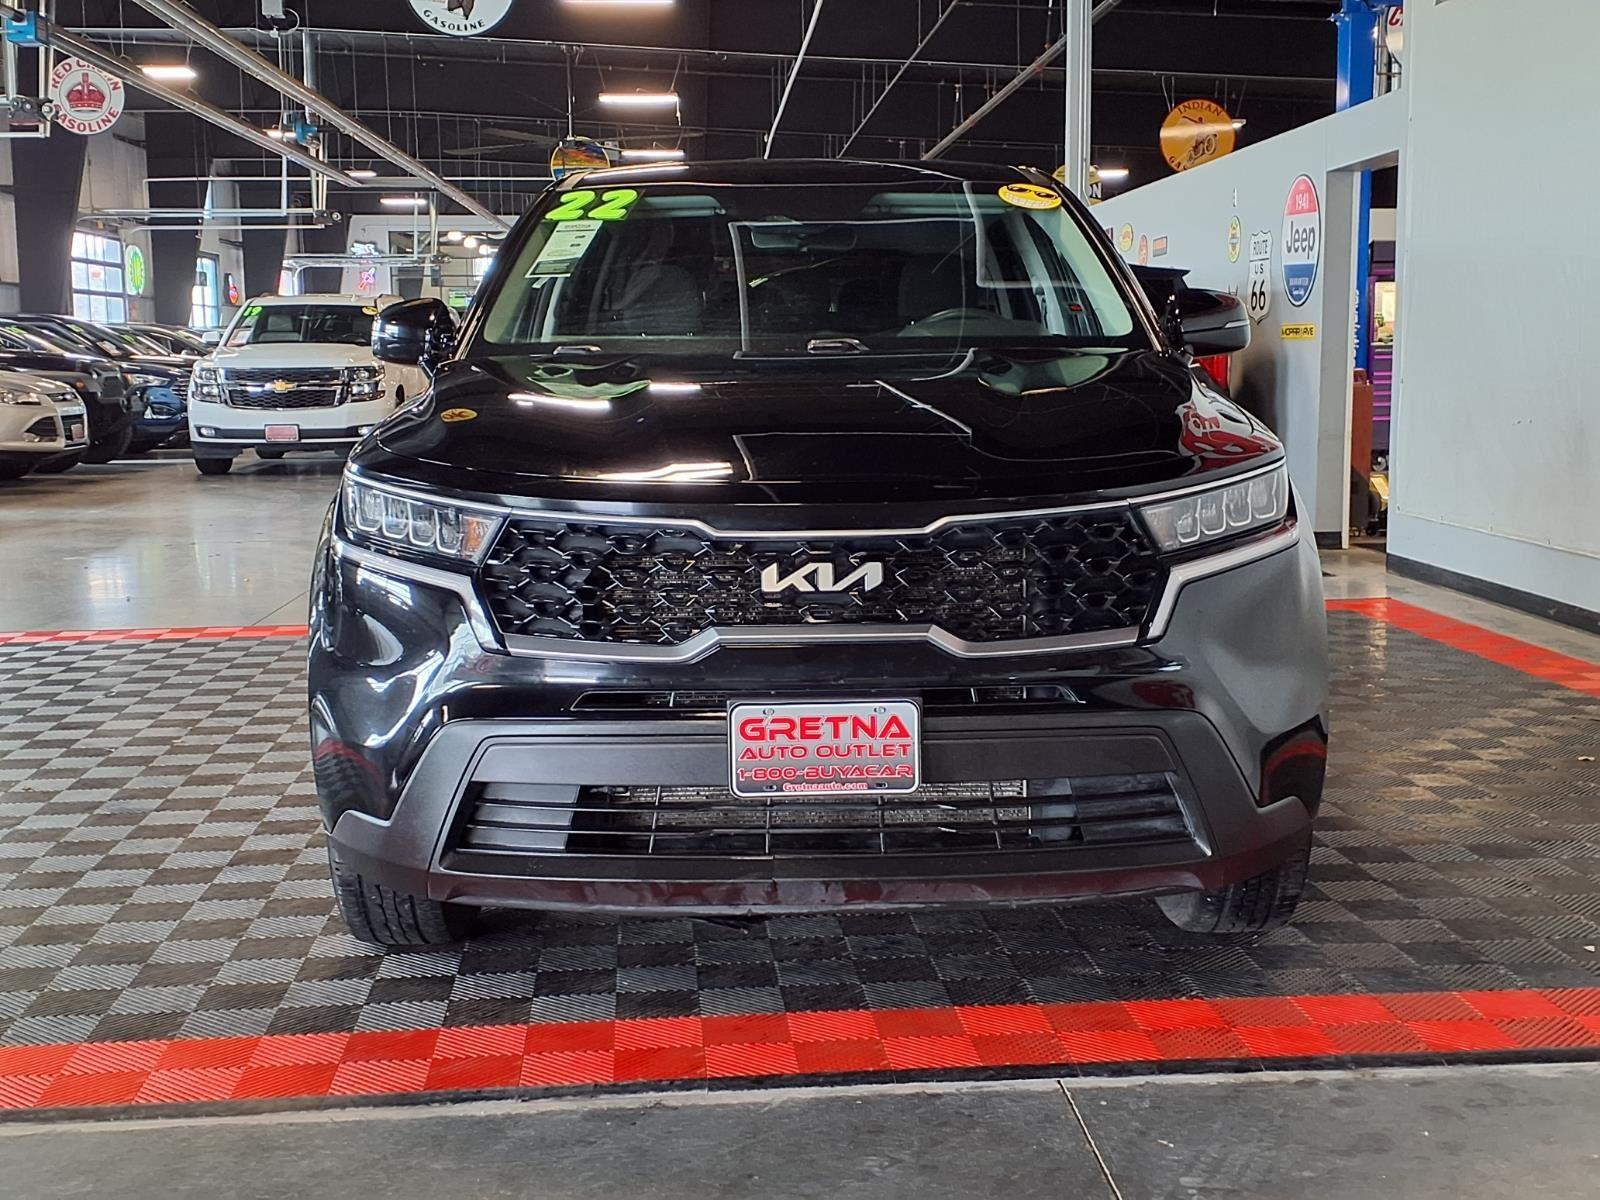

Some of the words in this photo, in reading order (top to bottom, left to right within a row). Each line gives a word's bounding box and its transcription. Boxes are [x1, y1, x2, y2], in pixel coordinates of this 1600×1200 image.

[423, 9, 486, 31] GASOLINE
[52, 62, 72, 89] RED
[1177, 101, 1222, 117] INDIAN
[545, 189, 638, 220] 22
[1295, 192, 1309, 211] 1941
[1253, 239, 1268, 256] ROUTE
[1286, 220, 1315, 259] Jeep
[1251, 278, 1266, 311] 66
[243, 306, 262, 316] 19
[738, 714, 912, 742] GRETNA
[738, 744, 808, 761] AUTO
[814, 743, 912, 759] OUTLET
[737, 764, 913, 781] 1-800-BUYACAR
